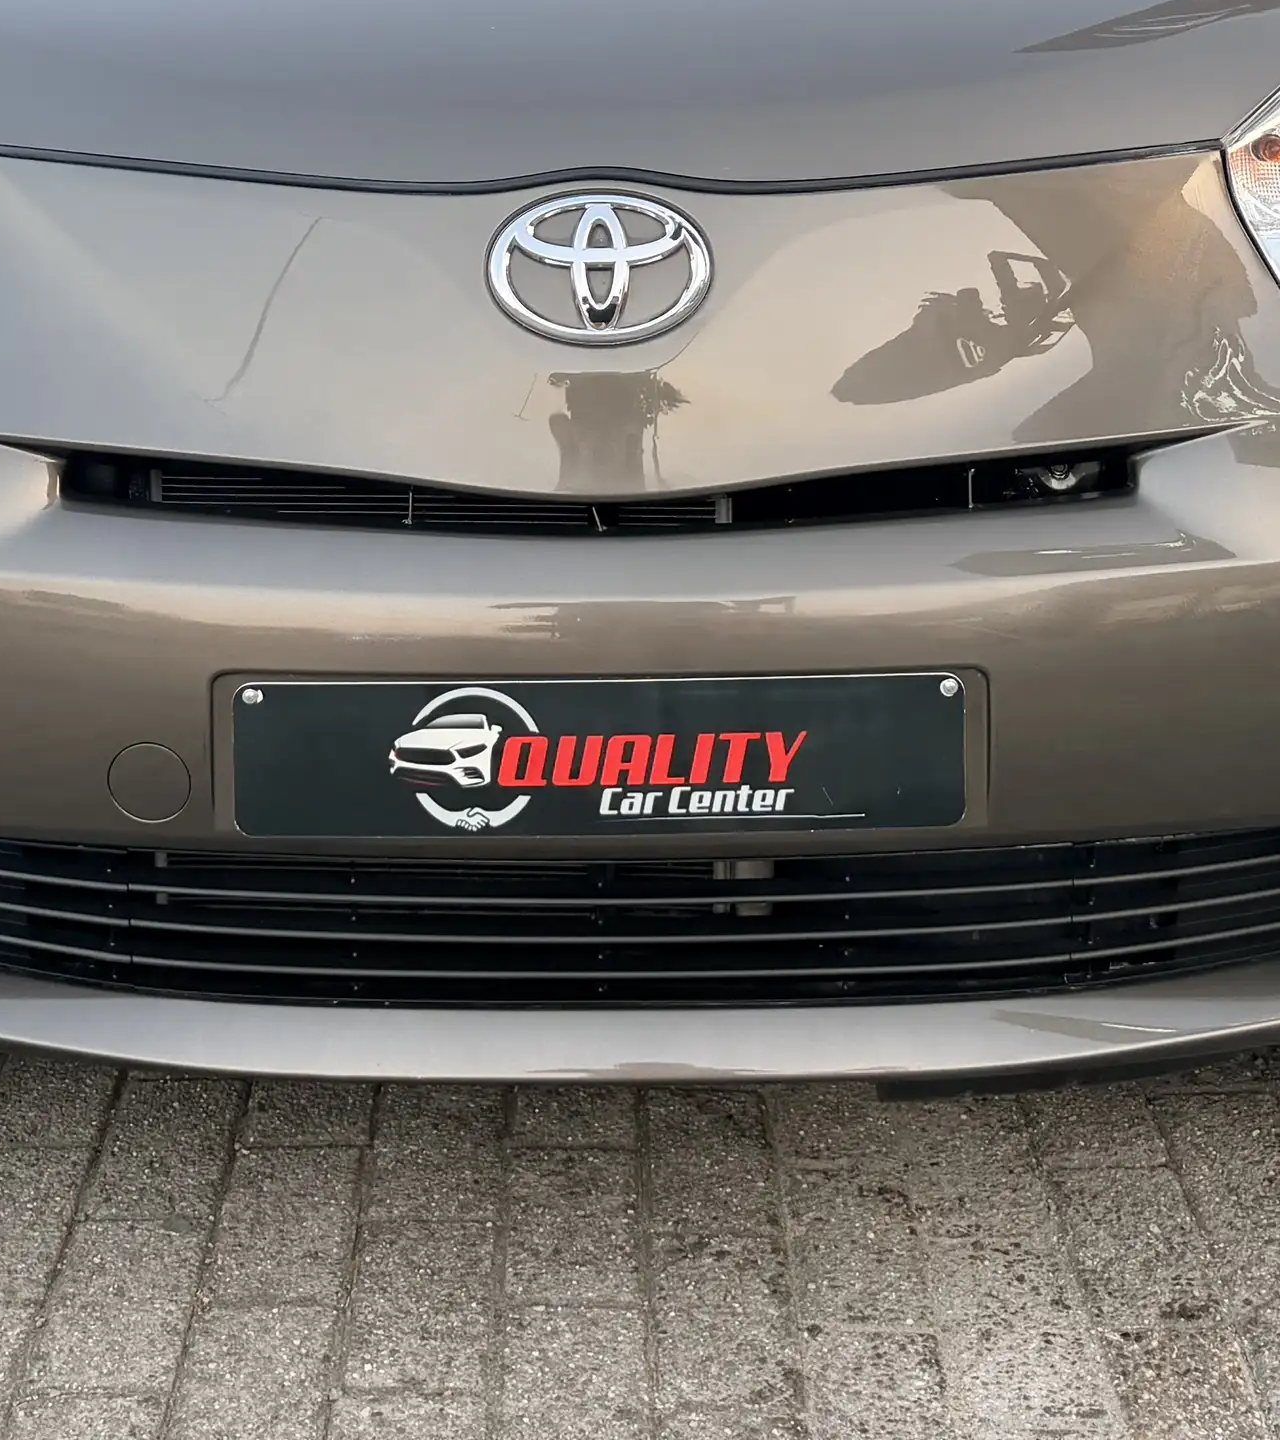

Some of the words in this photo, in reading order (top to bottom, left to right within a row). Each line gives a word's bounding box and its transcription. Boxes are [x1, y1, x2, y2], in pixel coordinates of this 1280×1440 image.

[497, 730, 808, 787] QUALITY
[599, 788, 663, 816] Car
[669, 785, 795, 815] Center
